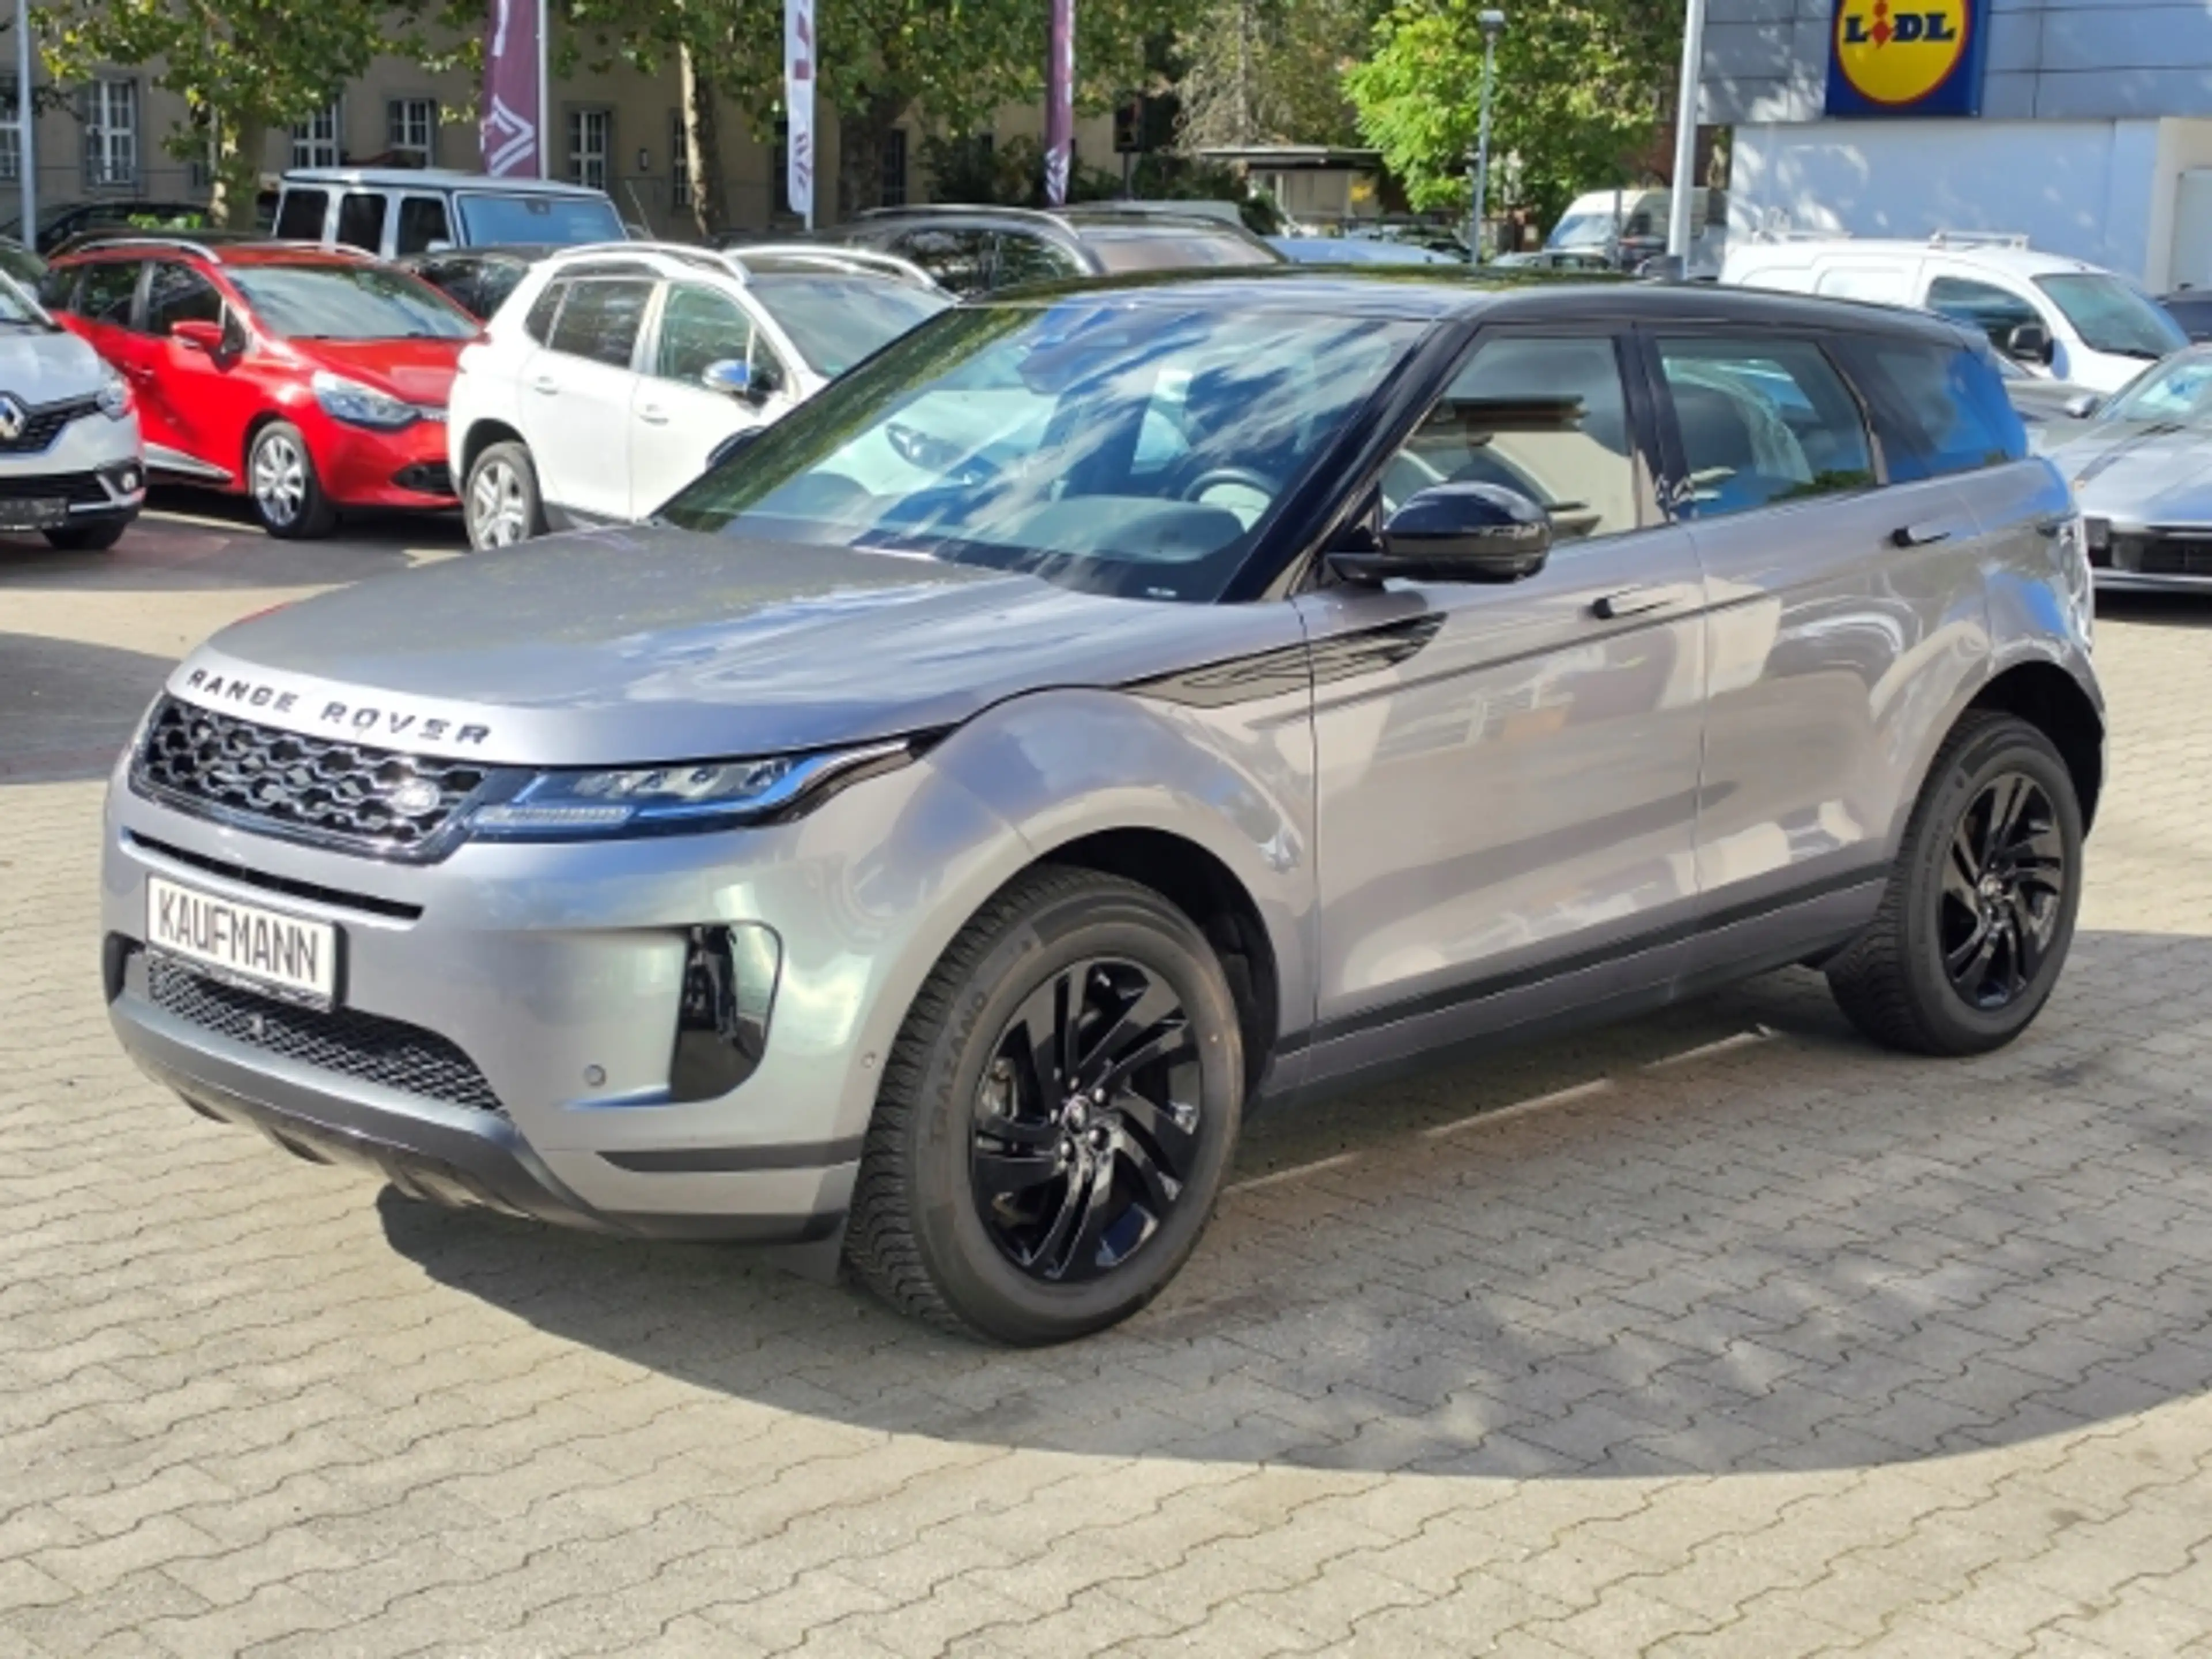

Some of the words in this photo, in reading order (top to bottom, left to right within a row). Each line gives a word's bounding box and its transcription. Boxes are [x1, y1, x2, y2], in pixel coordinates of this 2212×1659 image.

[186, 668, 300, 713] RANGE
[320, 700, 491, 745] ROVER
[158, 887, 319, 983] KAUFMANN
